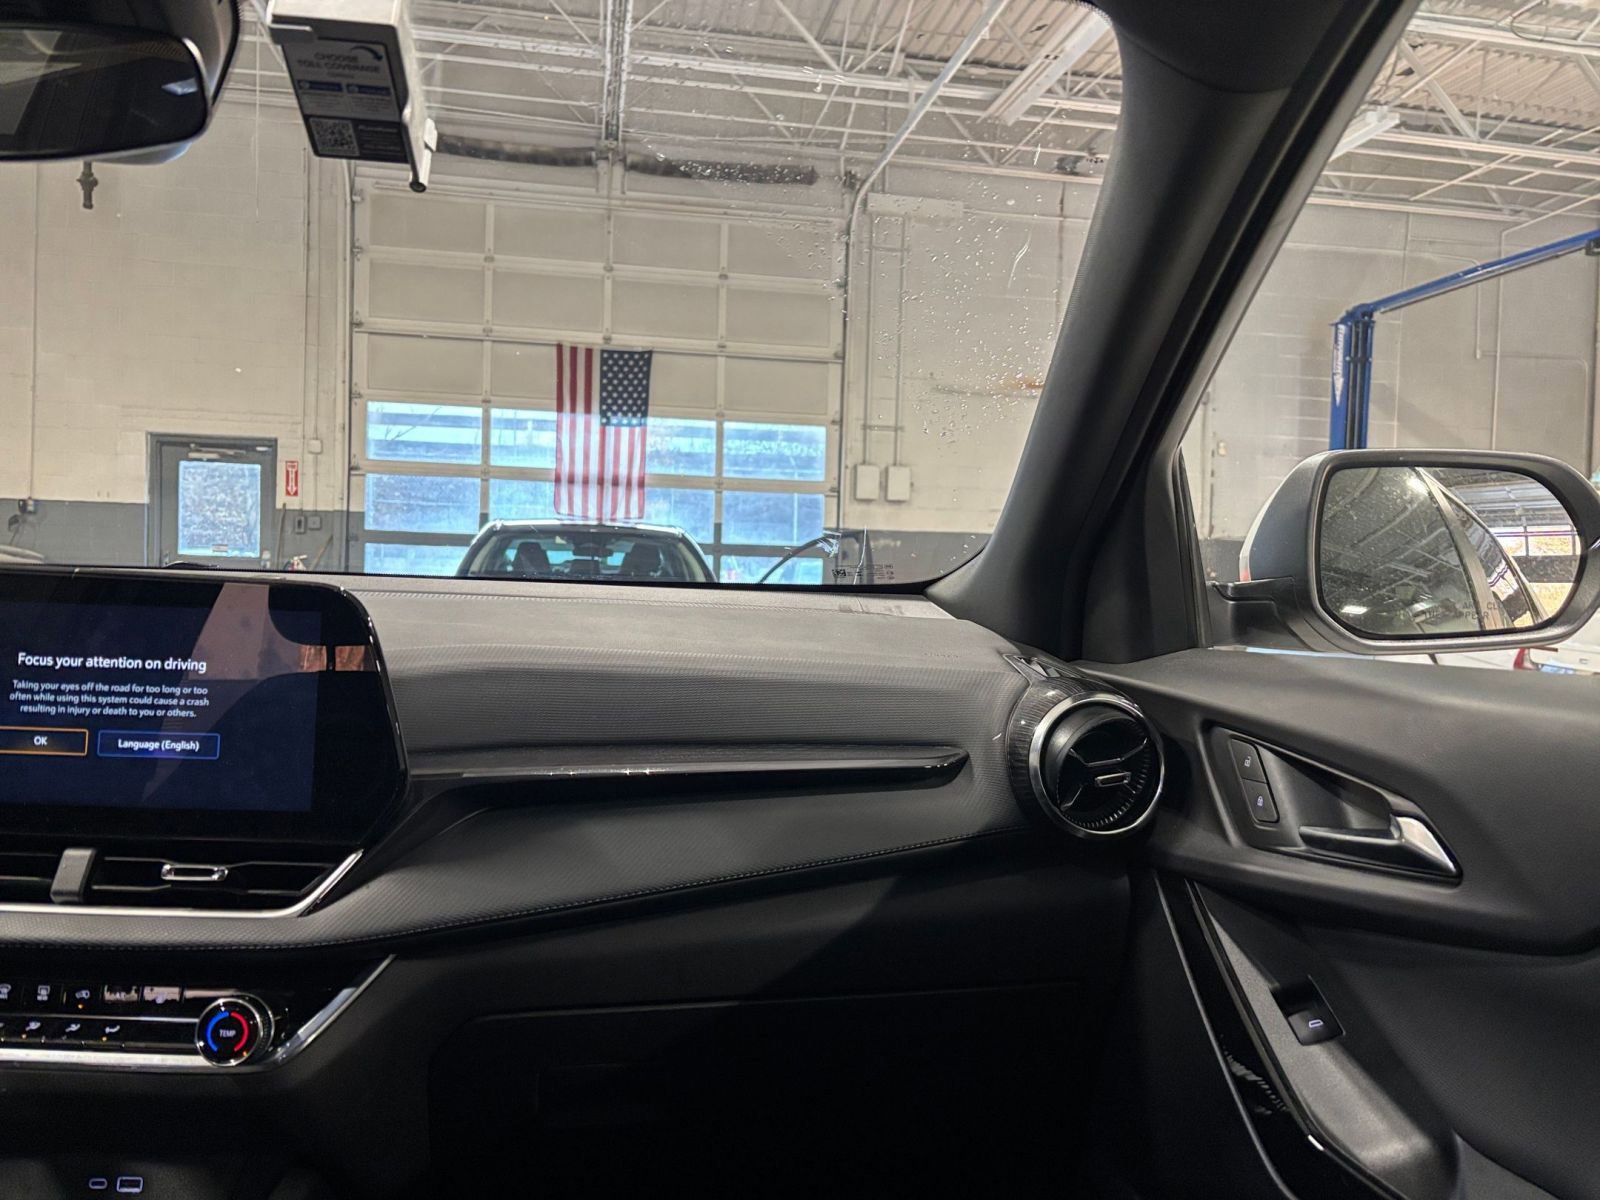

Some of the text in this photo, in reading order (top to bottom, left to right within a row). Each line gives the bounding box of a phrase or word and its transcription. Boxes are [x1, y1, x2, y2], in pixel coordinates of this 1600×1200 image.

[18, 651, 207, 674] Focus your attention on driving
[13, 679, 39, 692] Taking
[40, 683, 60, 691] your
[60, 684, 80, 692] eyes
[81, 682, 94, 691] off
[95, 682, 110, 691] the
[111, 684, 130, 693] road
[132, 683, 144, 693] for
[146, 685, 160, 693] too
[162, 685, 180, 696] long
[193, 687, 208, 695] too
[9, 691, 32, 700] often
[33, 693, 55, 702] while
[57, 694, 79, 704] using
[81, 694, 96, 703] this
[98, 696, 127, 705] system
[129, 696, 152, 705] could
[186, 697, 209, 706] crash
[20, 704, 56, 715] resulting
[58, 705, 65, 713] in
[67, 705, 91, 716] injury
[103, 706, 127, 715] death
[129, 707, 138, 715] to
[139, 709, 155, 718] you
[167, 708, 197, 717] others.
[34, 735, 48, 745] OK
[118, 738, 200, 753] Language (English)
[220, 1030, 236, 1038] TEMP
